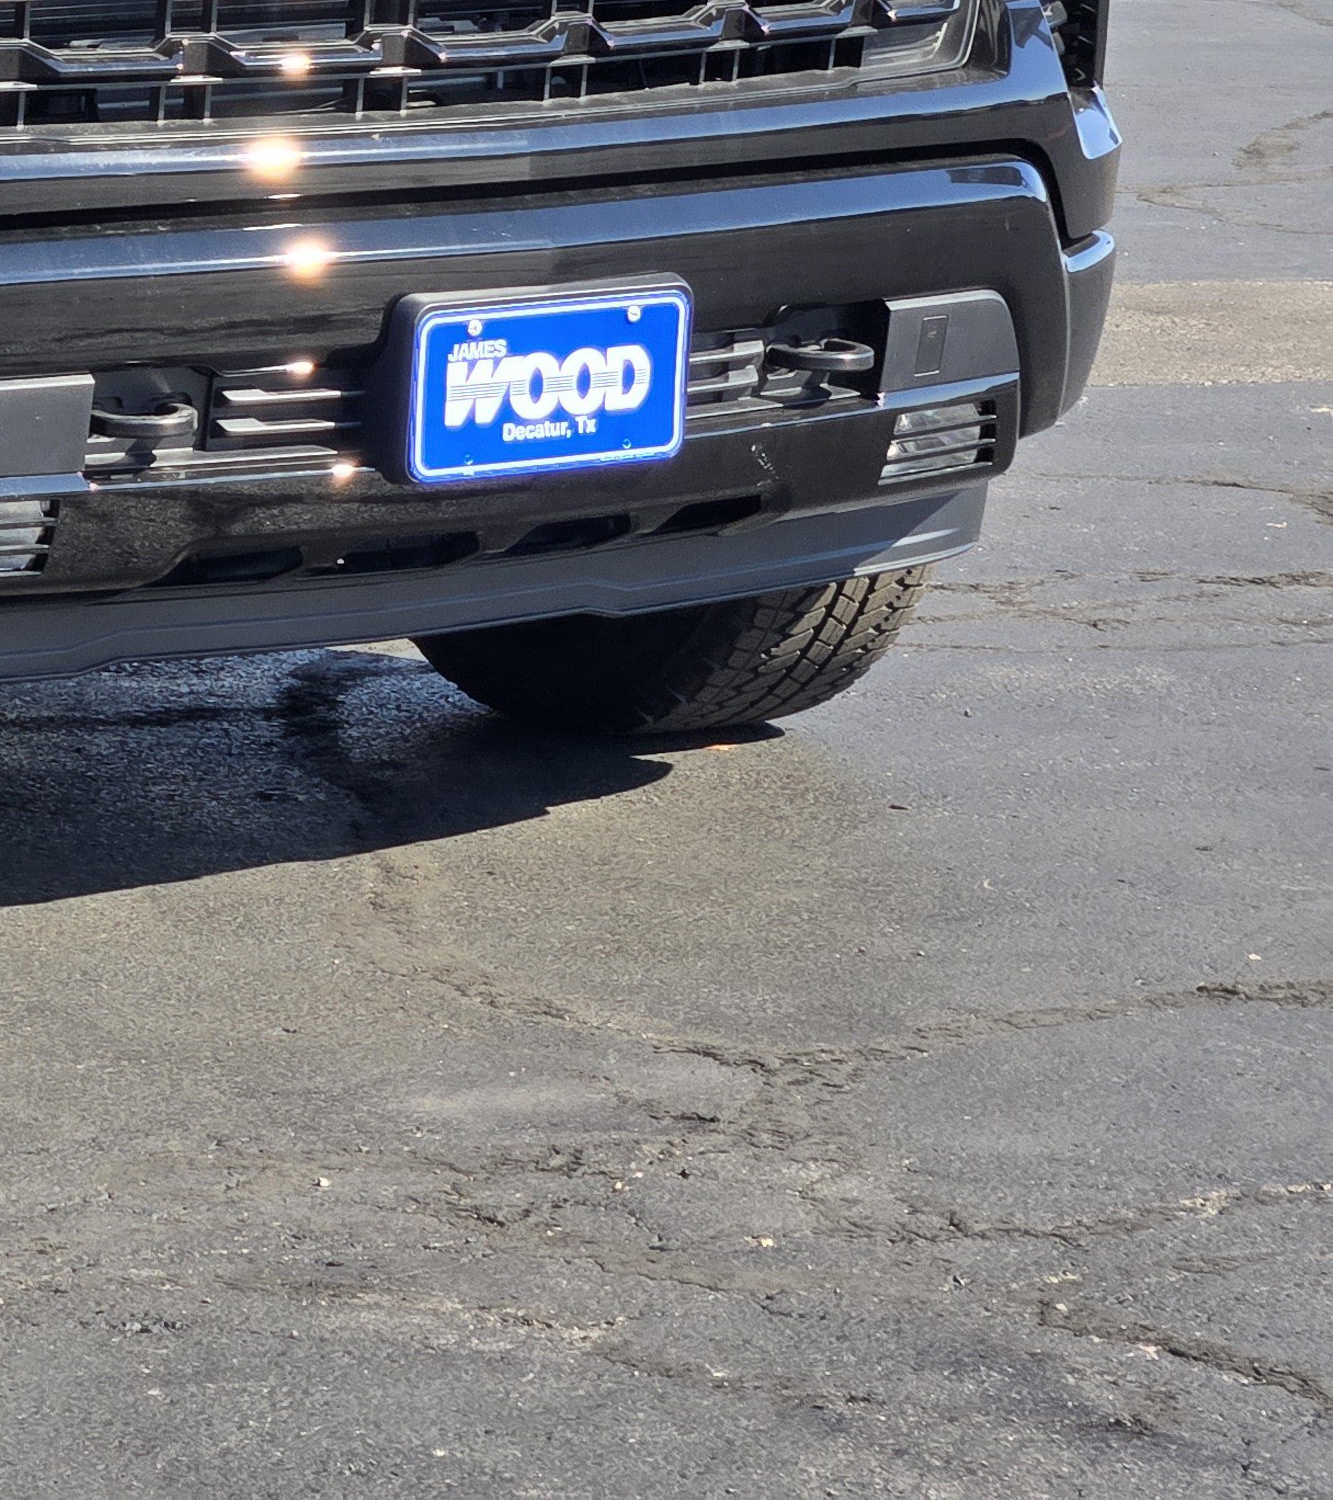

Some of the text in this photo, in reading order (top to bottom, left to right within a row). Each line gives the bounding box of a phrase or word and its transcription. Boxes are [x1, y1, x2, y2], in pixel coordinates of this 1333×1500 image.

[447, 339, 508, 362] JAMES
[444, 344, 652, 427] WOOD
[502, 415, 597, 442] Decatur, Tx
